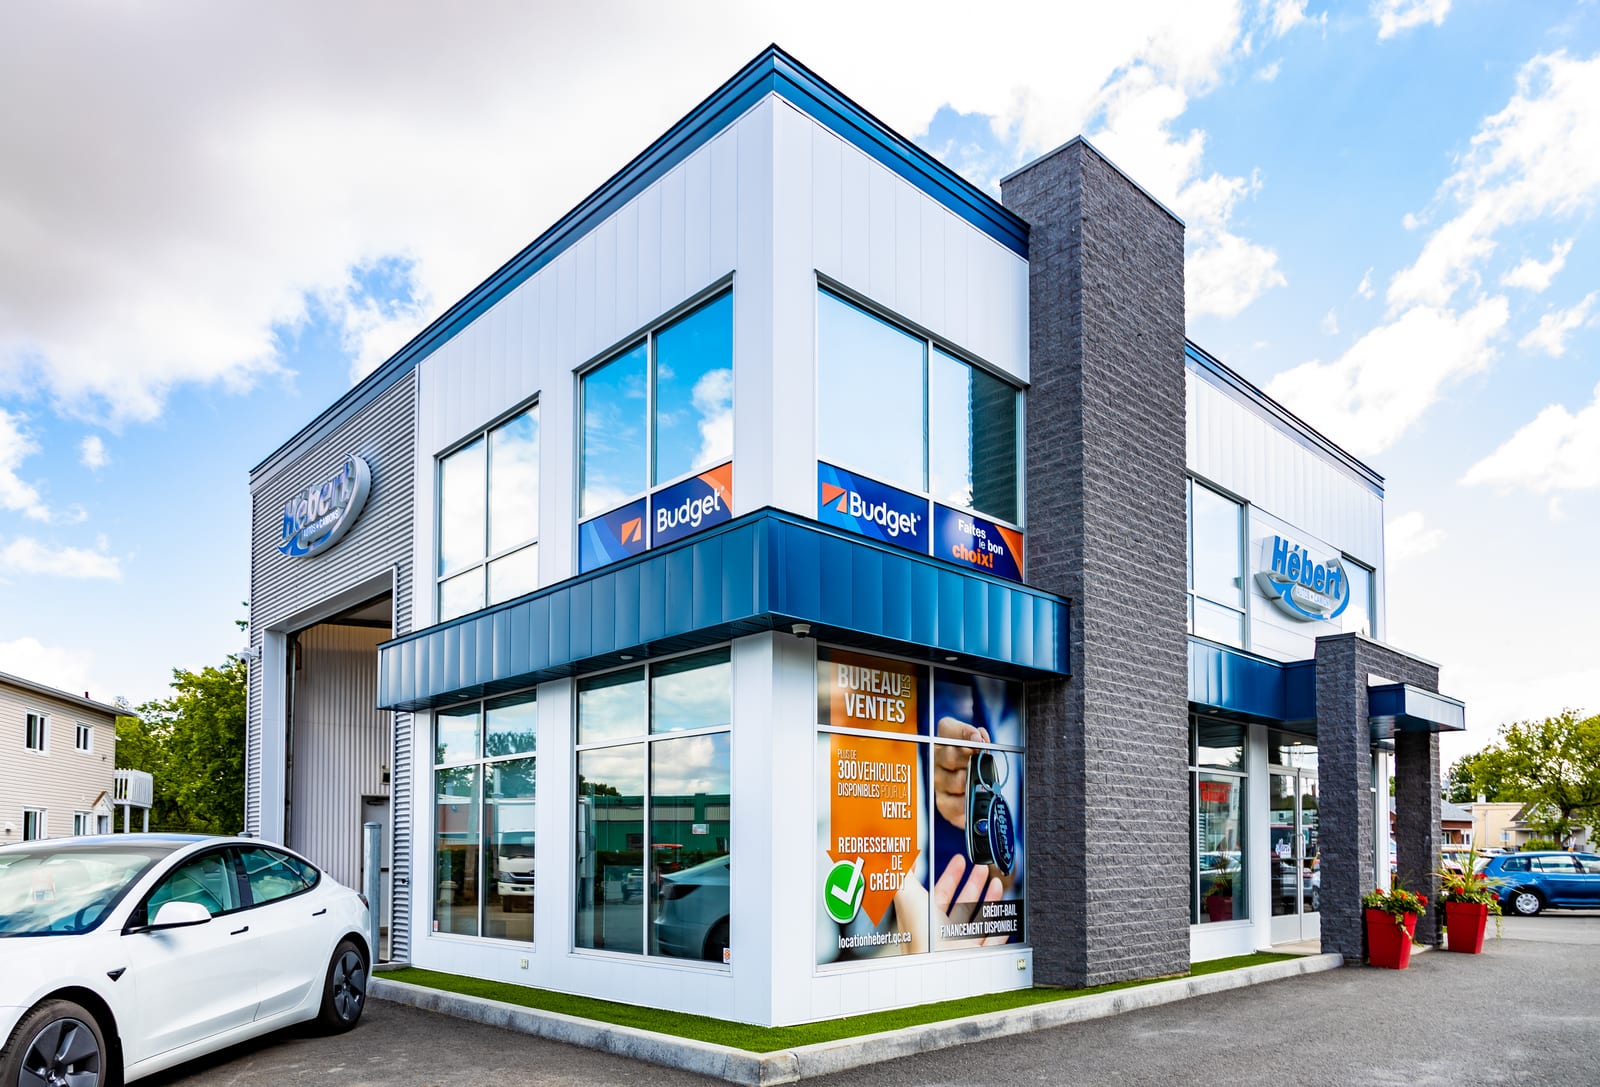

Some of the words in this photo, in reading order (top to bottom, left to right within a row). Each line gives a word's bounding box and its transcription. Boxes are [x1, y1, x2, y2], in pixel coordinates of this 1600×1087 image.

[657, 488, 721, 533] Budget
[849, 491, 918, 537] Budget
[957, 519, 986, 540] Faites
[952, 543, 994, 568] choix!
[987, 540, 1004, 556] bon
[1271, 535, 1342, 601] Hébert
[837, 663, 901, 697] BUREAU
[901, 673, 911, 698] DES
[844, 692, 906, 723] VENTES
[850, 749, 857, 760] DE
[837, 759, 857, 780] 300
[857, 761, 907, 783] VEHICULES
[837, 782, 880, 798] DISPONIBLES
[838, 836, 912, 854] REDRESSEMENT
[891, 855, 903, 871] DE
[869, 868, 906, 891] CRÉDIT
[982, 902, 1018, 918] CRÉDIT-BAIL
[940, 921, 983, 937] FINANCEMENT
[984, 919, 1018, 934] DISPONIBLE
[838, 931, 912, 949] locationhebert.qc.ca
